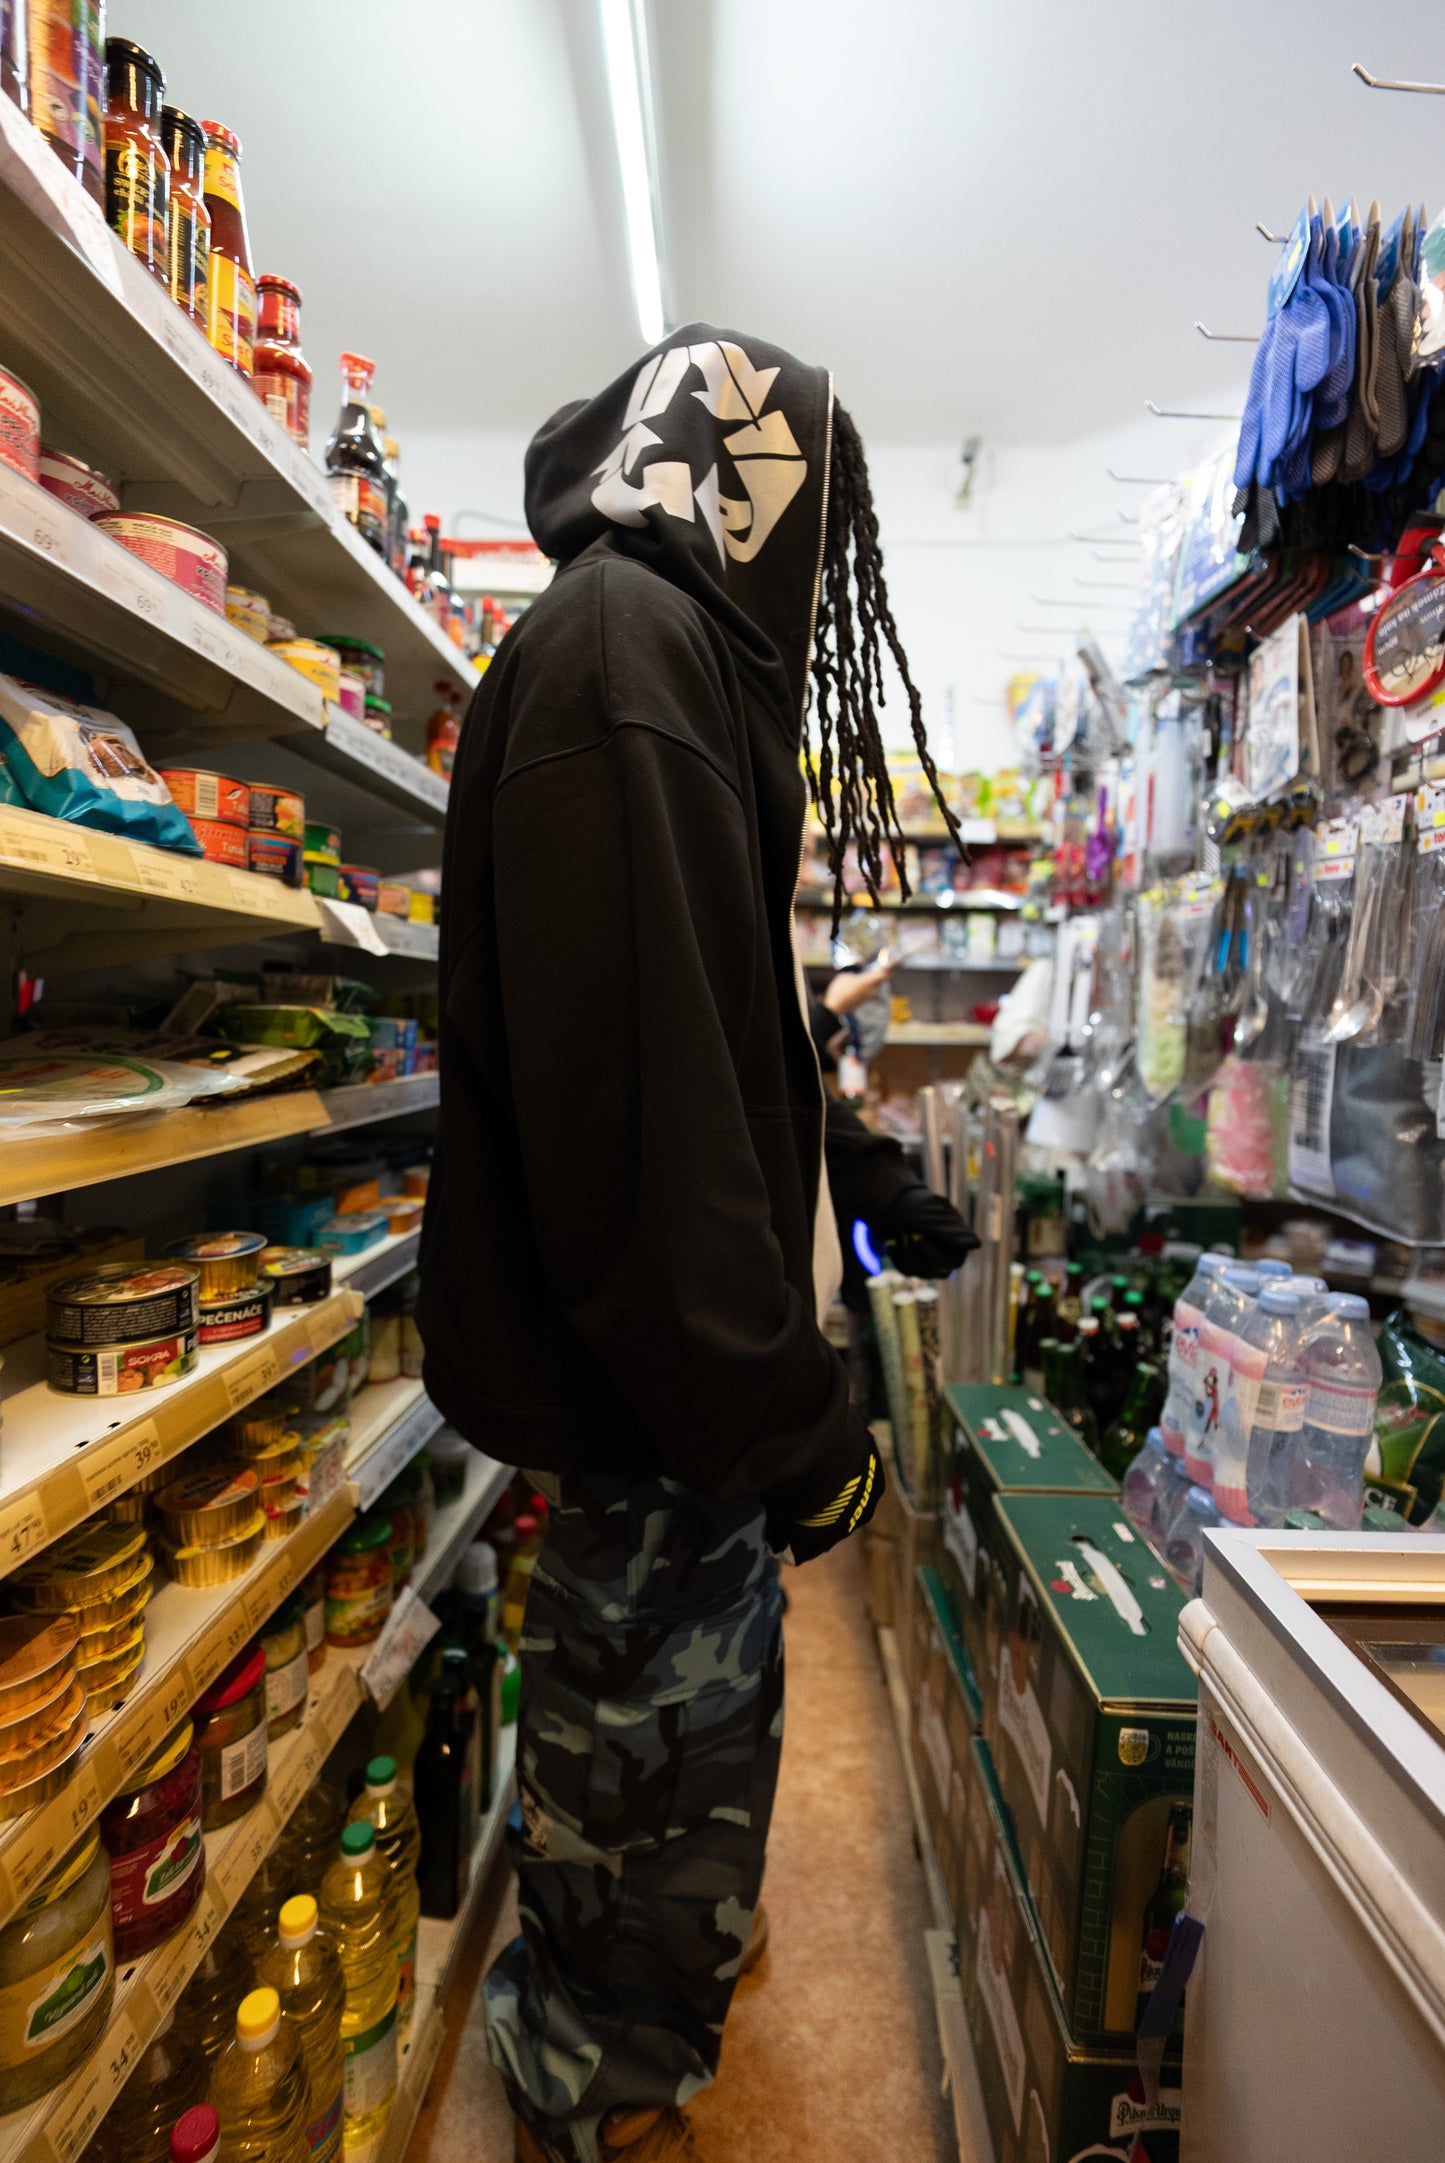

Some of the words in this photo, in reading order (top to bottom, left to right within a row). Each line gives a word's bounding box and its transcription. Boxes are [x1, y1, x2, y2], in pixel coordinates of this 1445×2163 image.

[199, 1303, 263, 1326] PEČENÁČE
[127, 1349, 171, 1367] SOKRA
[135, 1446, 151, 1470] 39
[12, 1525, 31, 1552] 47
[165, 1702, 179, 1724] 19
[71, 1803, 89, 1829] 19
[110, 2050, 129, 2084] 34
